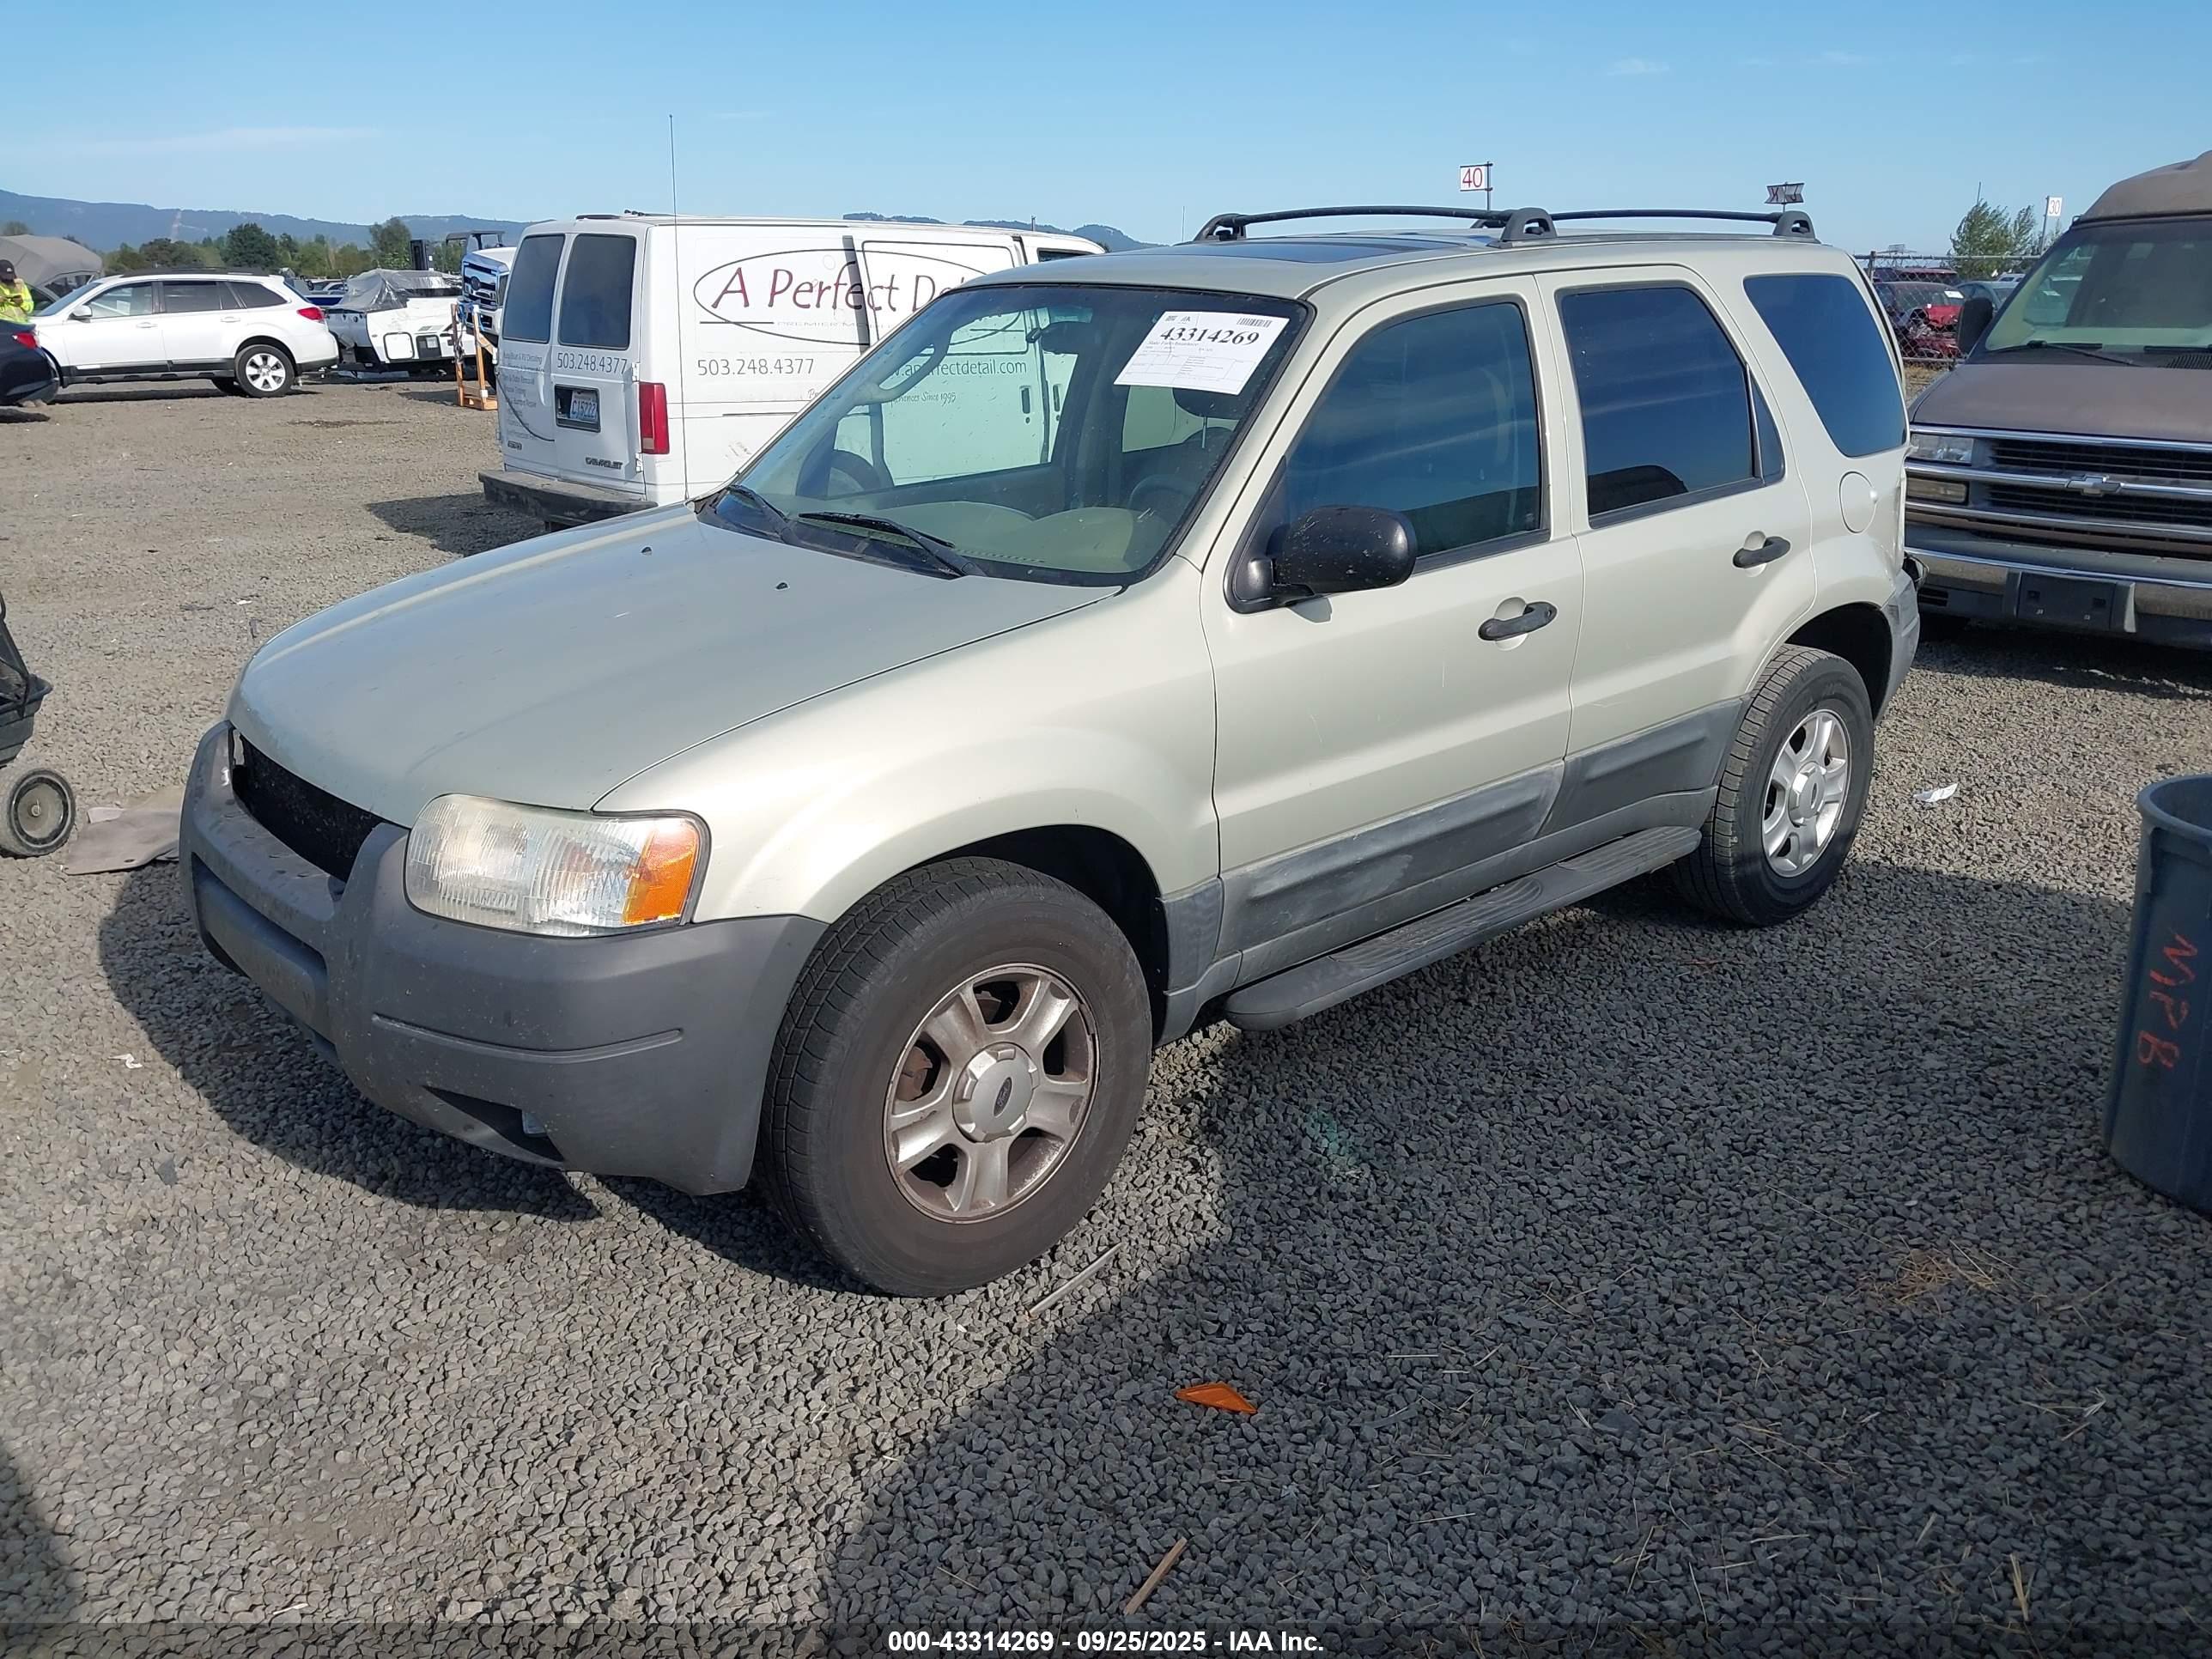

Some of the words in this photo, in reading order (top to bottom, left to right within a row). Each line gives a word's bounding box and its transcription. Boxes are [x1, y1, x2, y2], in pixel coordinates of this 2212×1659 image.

[1462, 167, 1482, 188] 40
[2049, 199, 2061, 215] 30
[711, 267, 750, 309] A
[768, 260, 899, 312] Perfect
[1160, 326, 1260, 346] 43314269
[557, 353, 628, 374] 503.248.4377
[698, 358, 814, 376] 503.248.4377
[940, 392, 957, 407] 1995
